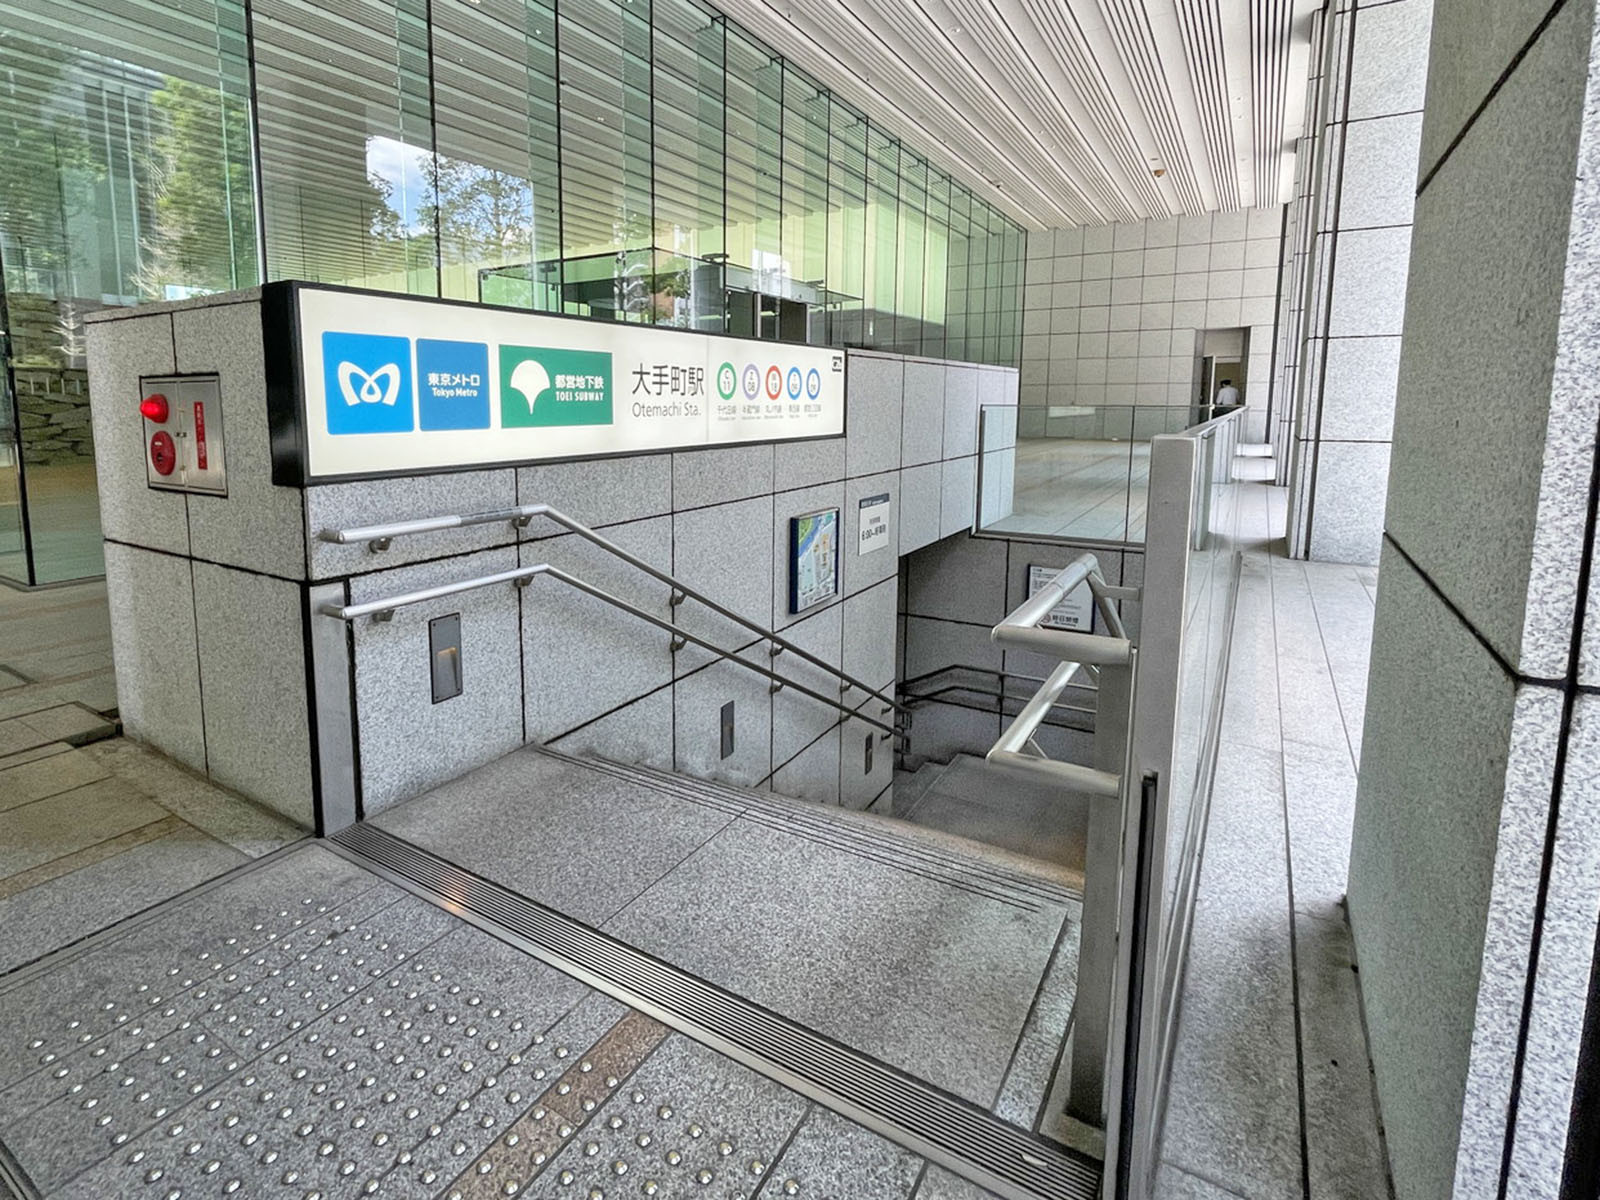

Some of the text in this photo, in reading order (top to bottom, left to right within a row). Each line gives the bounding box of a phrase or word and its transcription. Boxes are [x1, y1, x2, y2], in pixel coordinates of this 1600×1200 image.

[427, 372, 481, 387] 東京メトロ
[554, 374, 605, 390] 都営地下鉄
[631, 362, 705, 397] 大手町駅
[431, 387, 478, 399] Tokyo Metro
[555, 391, 604, 401] TOEI SUBWAY
[631, 401, 702, 418] Otemachi Sta.
